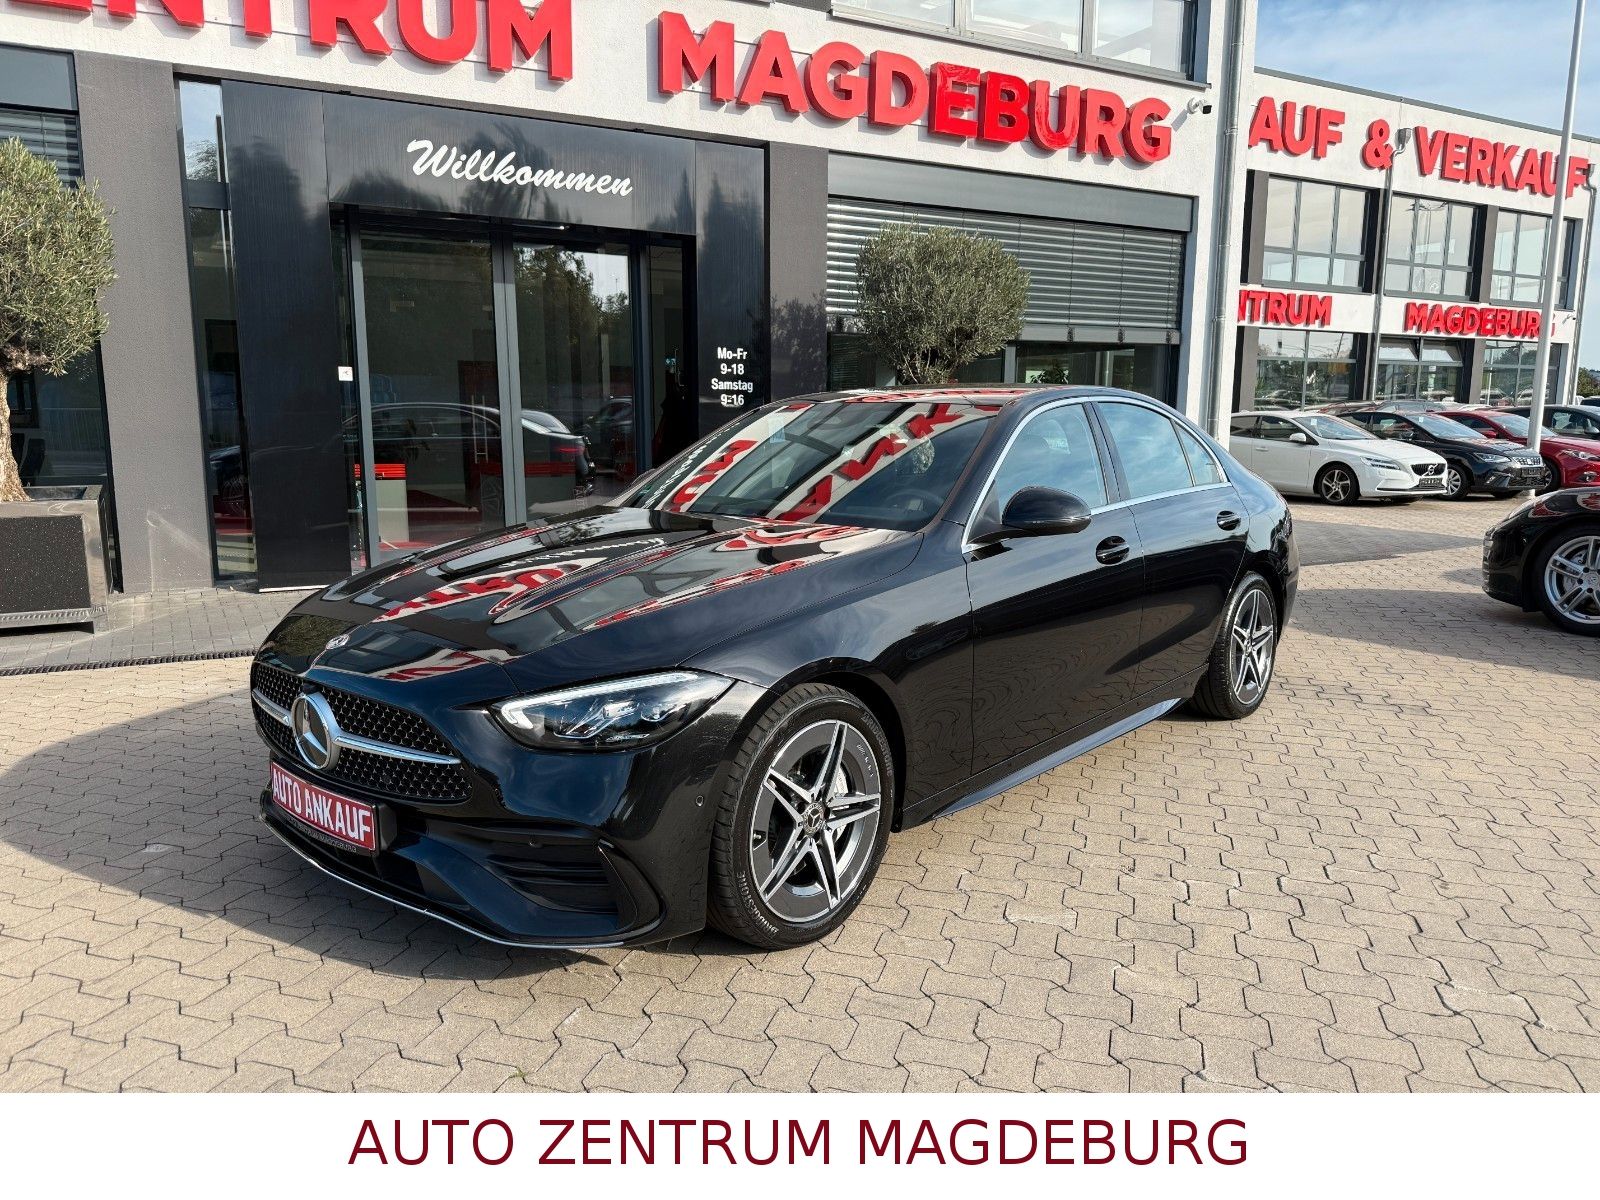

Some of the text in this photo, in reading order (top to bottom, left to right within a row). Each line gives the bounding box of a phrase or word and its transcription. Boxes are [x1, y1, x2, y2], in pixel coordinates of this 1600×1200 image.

[657, 11, 1173, 164] MAGDEBURG
[1249, 96, 1590, 199] AUF & VERKAUF
[406, 138, 633, 196] Willkommen
[1403, 302, 1555, 338] MAGDEBUR
[717, 346, 748, 360] Mo-Fr
[720, 362, 745, 375] 9-18
[711, 377, 754, 393] Samstag
[720, 393, 745, 407] 9-16
[272, 767, 302, 814] AUTO
[304, 787, 371, 842] ANKAUF
